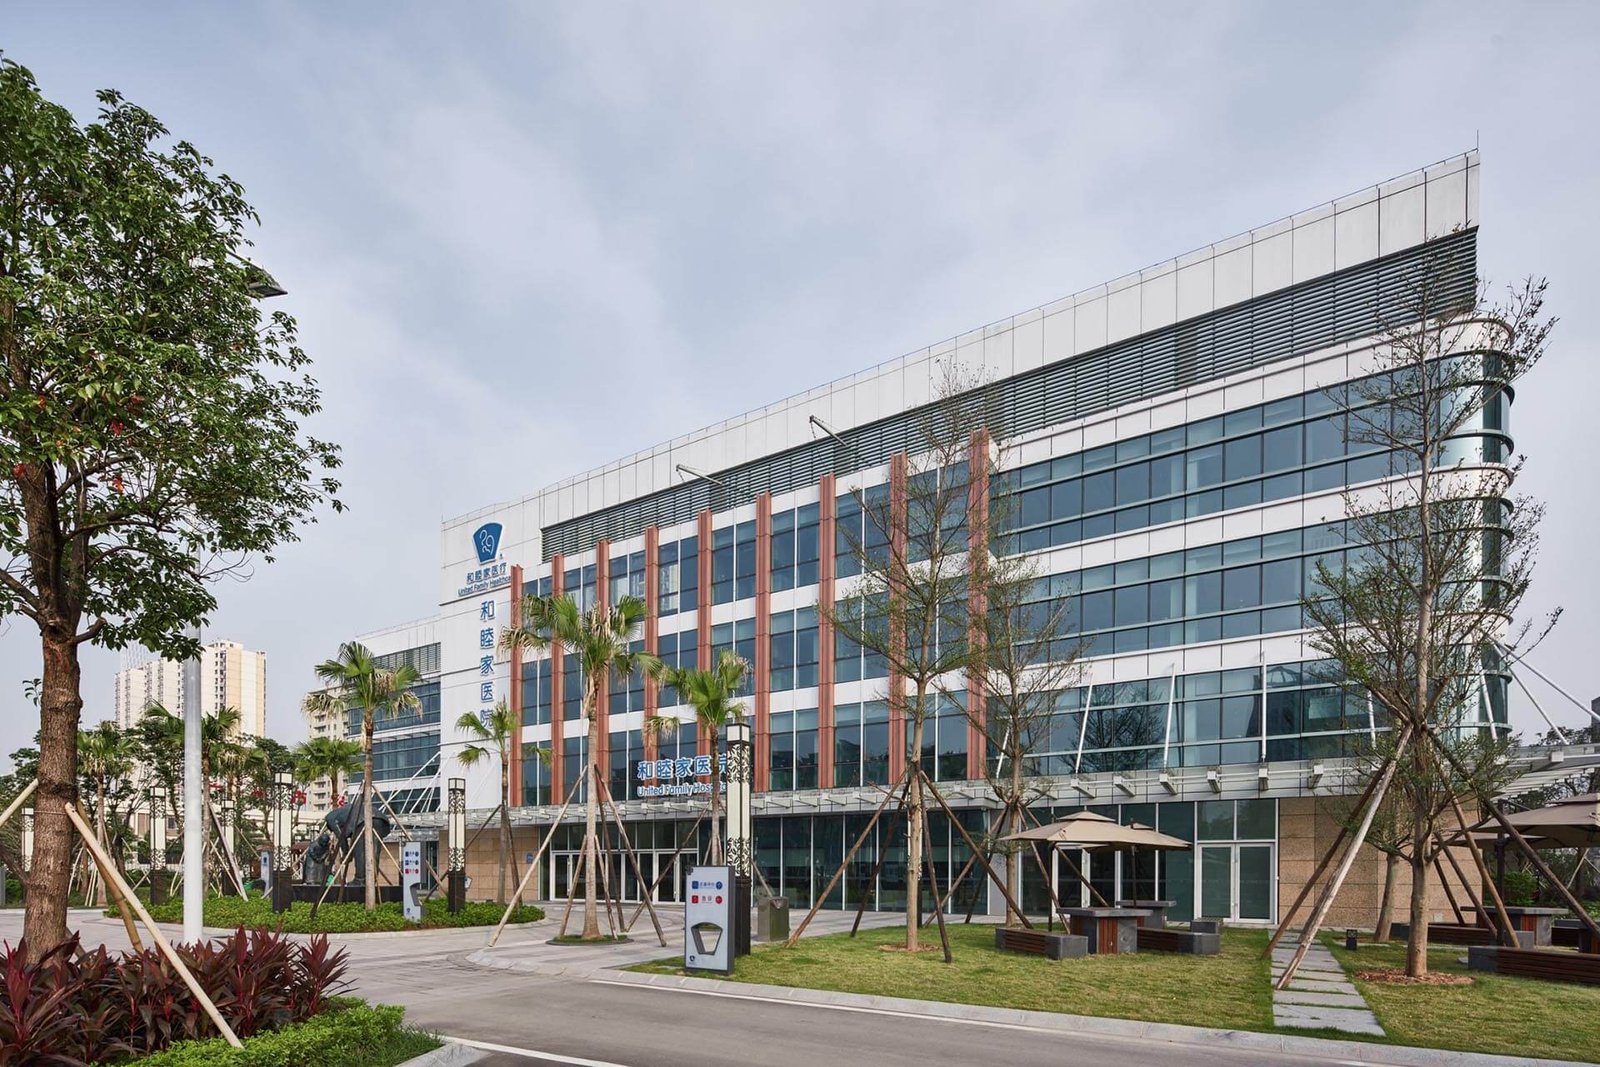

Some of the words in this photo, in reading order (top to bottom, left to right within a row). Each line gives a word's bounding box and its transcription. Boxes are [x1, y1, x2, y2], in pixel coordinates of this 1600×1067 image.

[458, 585, 474, 595] United
[474, 580, 489, 591] Family
[490, 575, 511, 587] Healthca
[637, 784, 664, 796] United
[665, 781, 692, 796] Family
